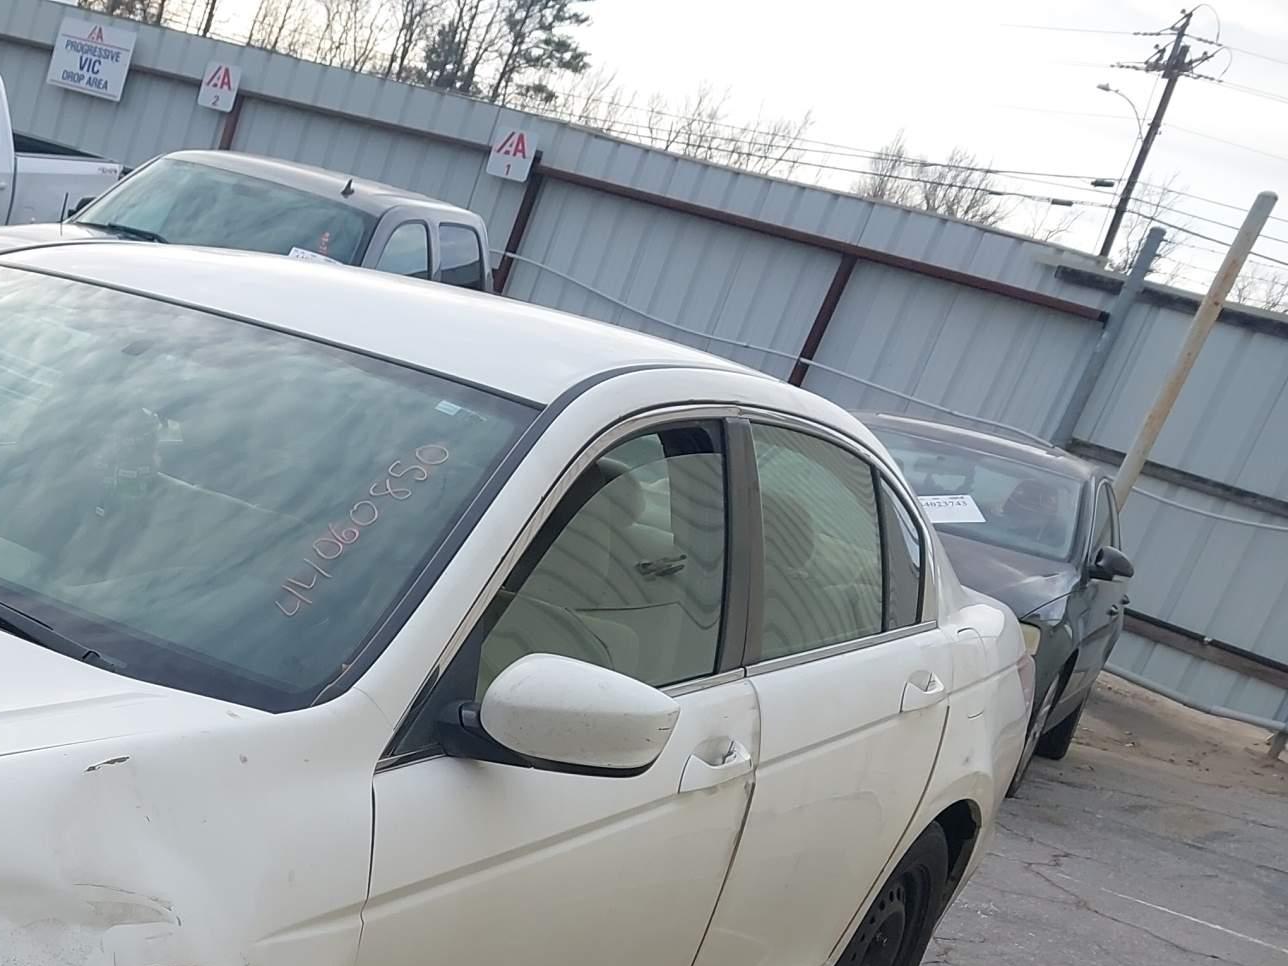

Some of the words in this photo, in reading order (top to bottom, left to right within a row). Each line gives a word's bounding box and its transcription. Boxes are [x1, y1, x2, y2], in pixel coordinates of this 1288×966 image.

[64, 39, 122, 63] PROGRESSIVE
[79, 55, 102, 75] VIC
[61, 69, 85, 85] DROP
[85, 76, 109, 92] AREA
[211, 95, 220, 107] 2
[505, 163, 512, 177] 1
[274, 443, 450, 617] 44060850
